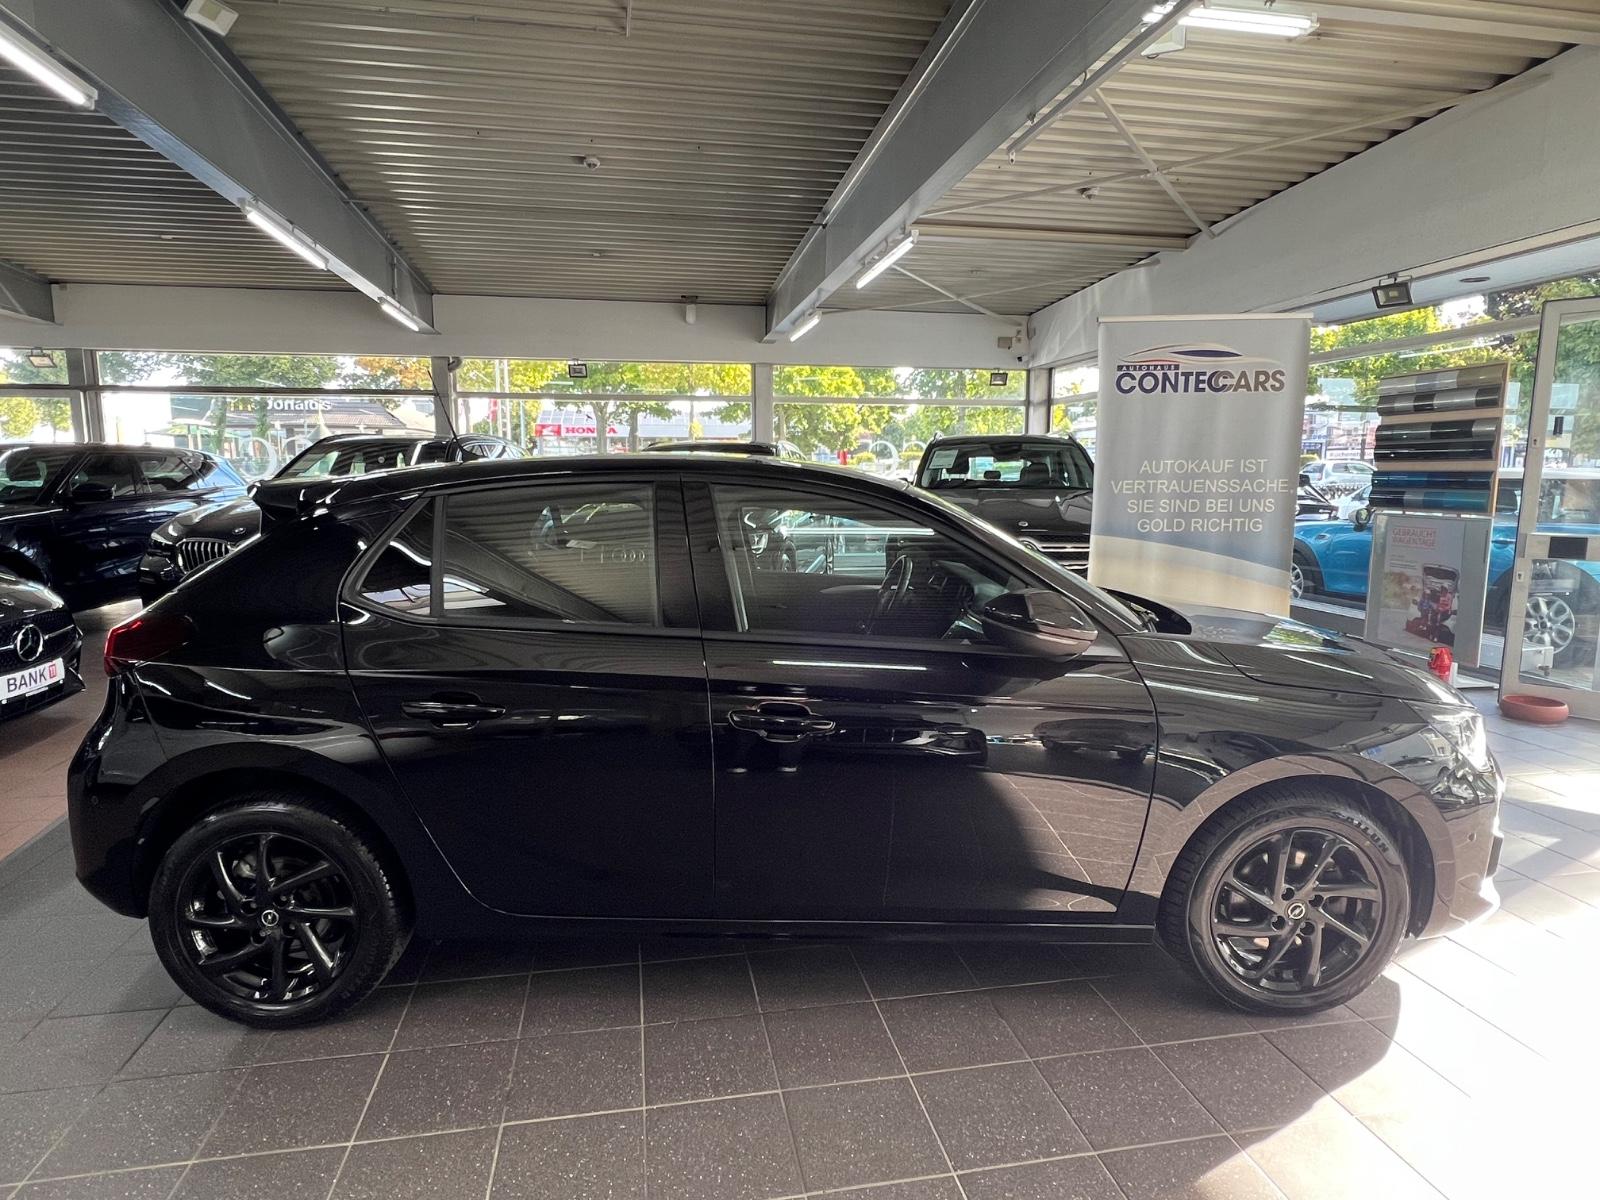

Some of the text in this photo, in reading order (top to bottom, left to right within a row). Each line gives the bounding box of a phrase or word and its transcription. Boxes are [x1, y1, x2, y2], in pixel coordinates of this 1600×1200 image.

[1139, 459, 1268, 474] AUTOKAUF IST
[1127, 498, 1275, 513] SIE SIND BEI UNS
[1137, 518, 1263, 532] GOLD RICHTIG
[1392, 528, 1437, 538] GEBRAUCHT
